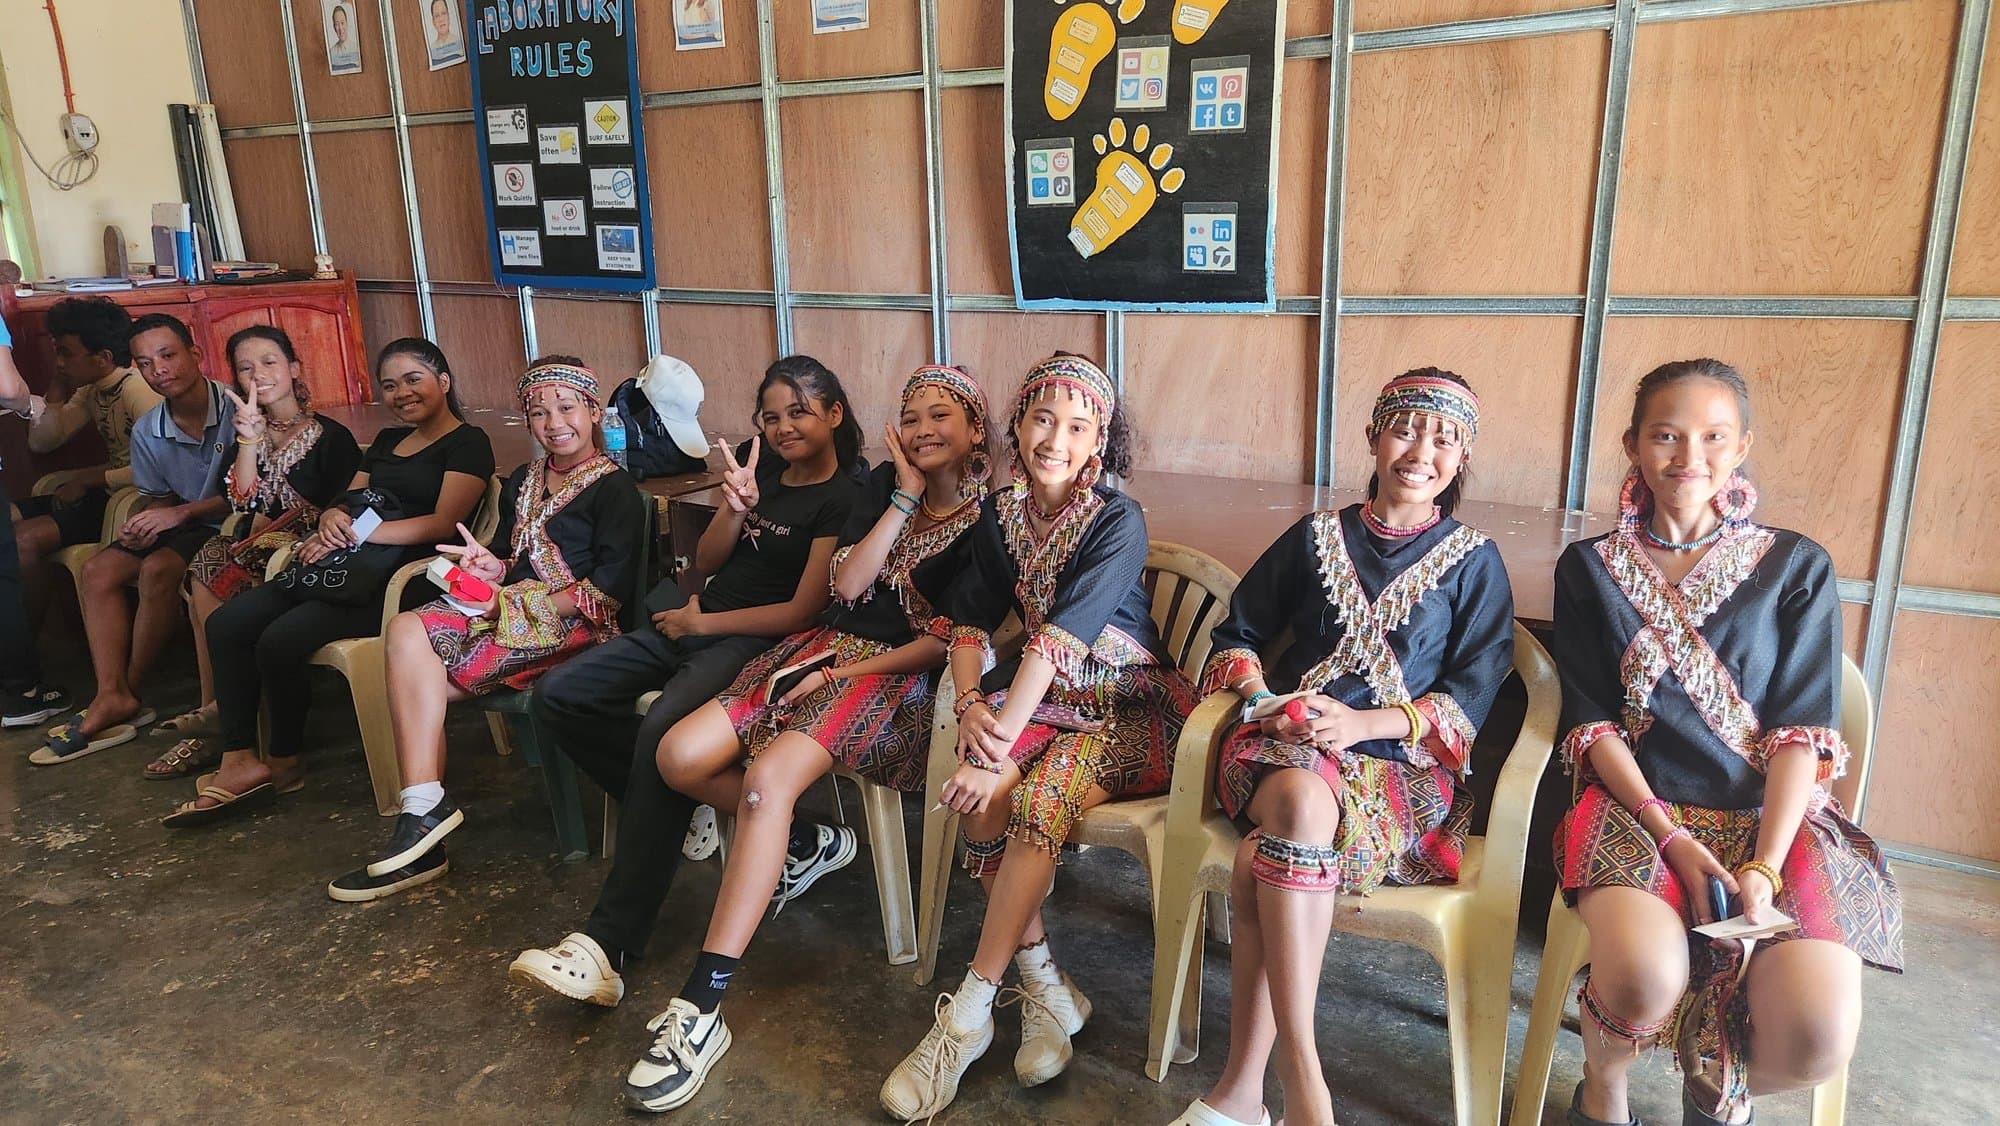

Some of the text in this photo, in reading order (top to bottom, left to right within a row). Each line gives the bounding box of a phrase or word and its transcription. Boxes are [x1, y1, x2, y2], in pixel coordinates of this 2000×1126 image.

[477, 0, 623, 54] LABORATORY
[509, 39, 594, 77] RULES
[541, 147, 560, 155] often
[513, 194, 533, 203] Quietly
[775, 525, 791, 536] girl
